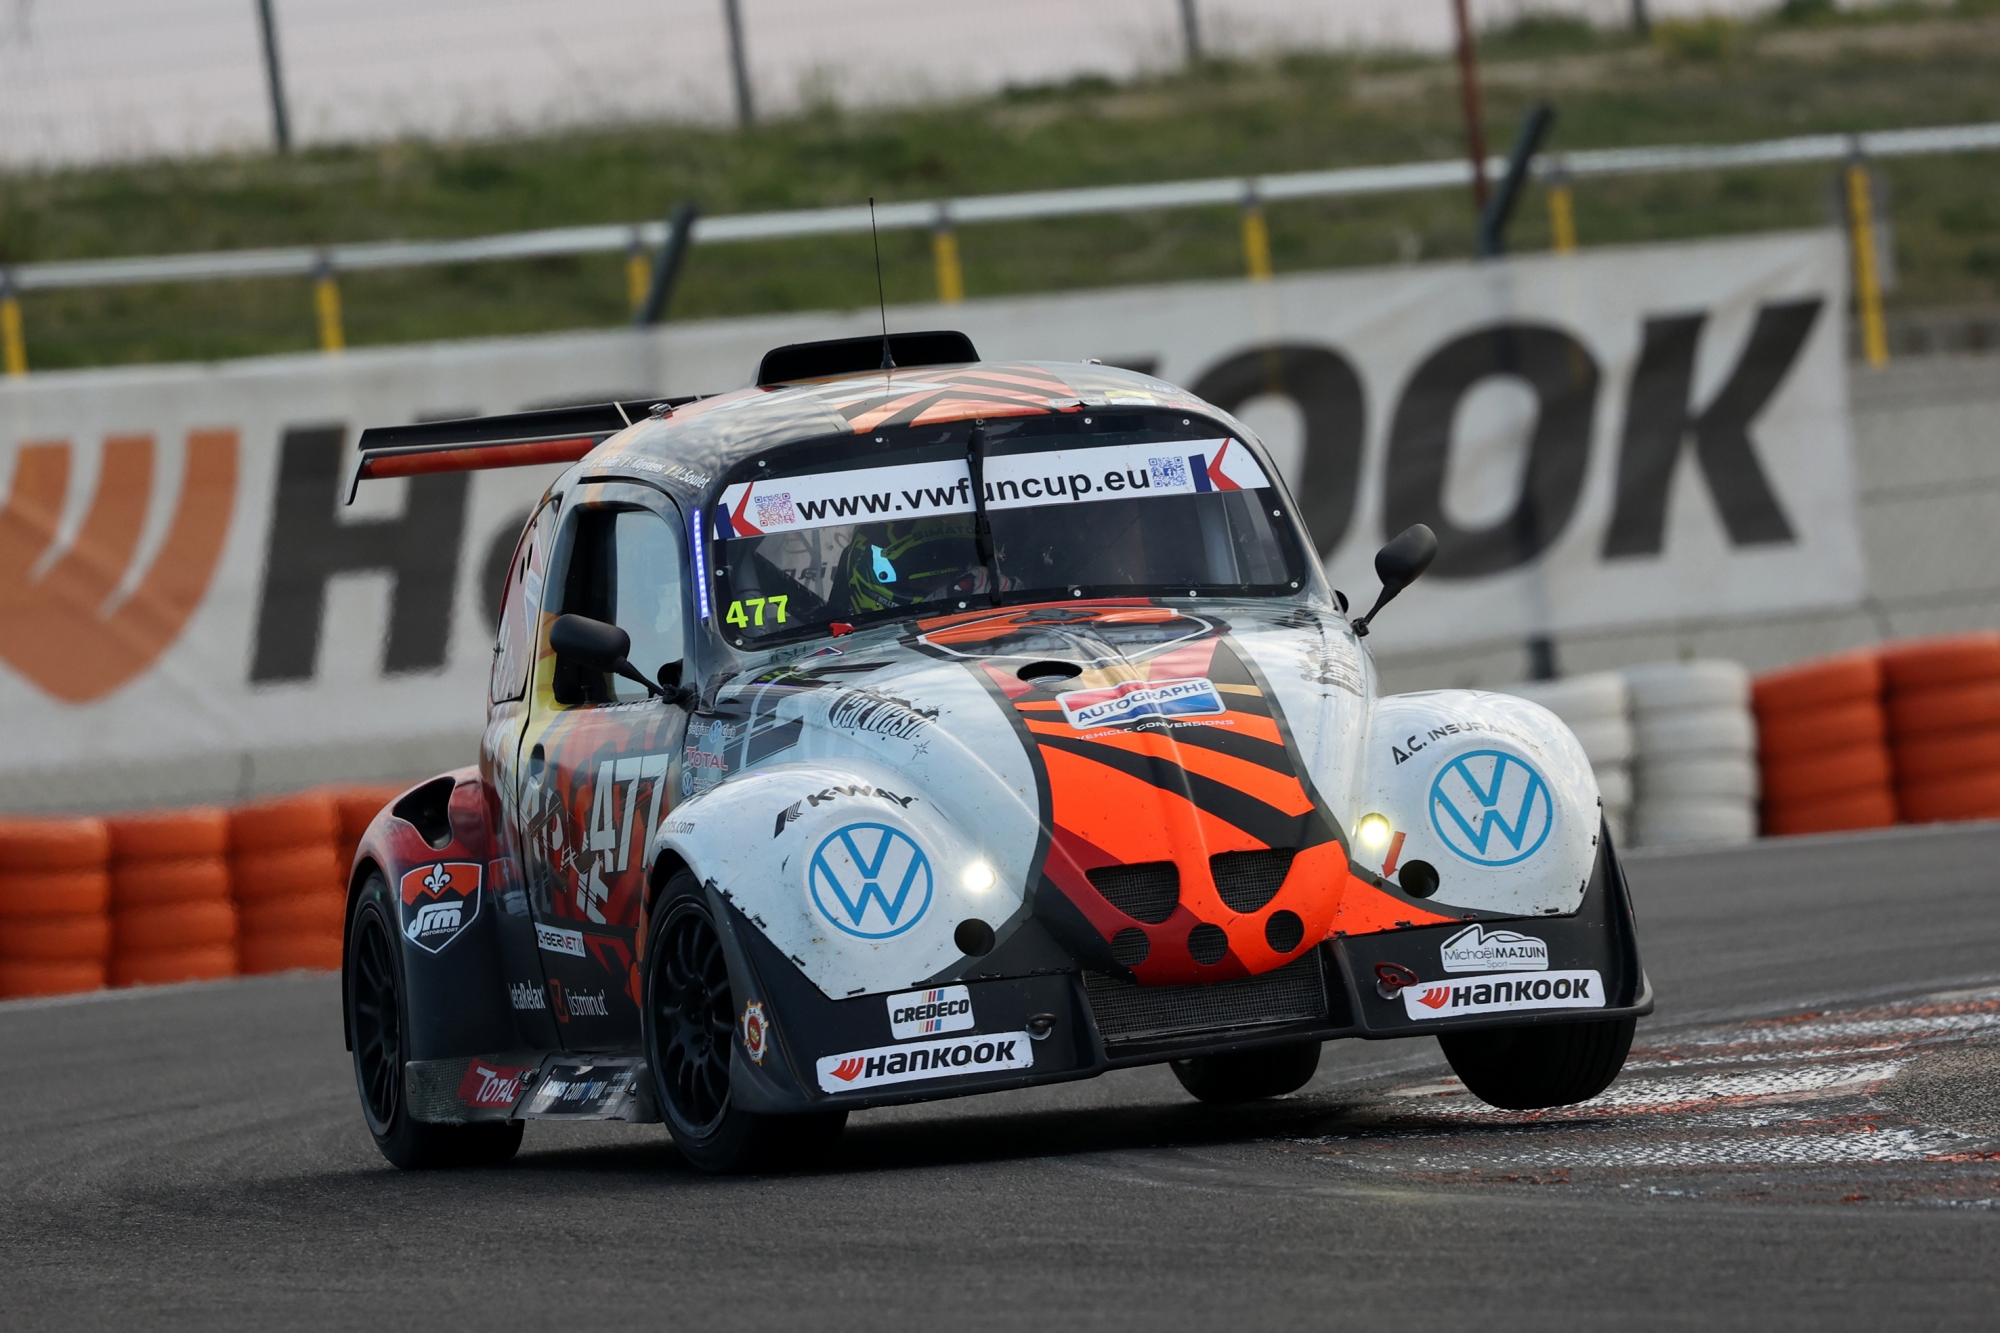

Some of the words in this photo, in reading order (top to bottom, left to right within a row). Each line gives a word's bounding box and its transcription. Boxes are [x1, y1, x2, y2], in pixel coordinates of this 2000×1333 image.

[796, 468, 1150, 521] www.vwfuncup.eu
[726, 594, 788, 628] 477
[1077, 682, 1211, 723] AUTOGRAPHE
[721, 723, 736, 739] Club
[1075, 727, 1133, 741] VEHICLE
[1136, 719, 1236, 732] CONVERSIONS
[686, 745, 729, 771] TOTAL
[589, 753, 669, 873] 477
[420, 926, 460, 938] MOTORSPORT
[1486, 959, 1509, 969] Sport
[892, 998, 970, 1026] CREDECO
[476, 1065, 519, 1103] TOTAL
